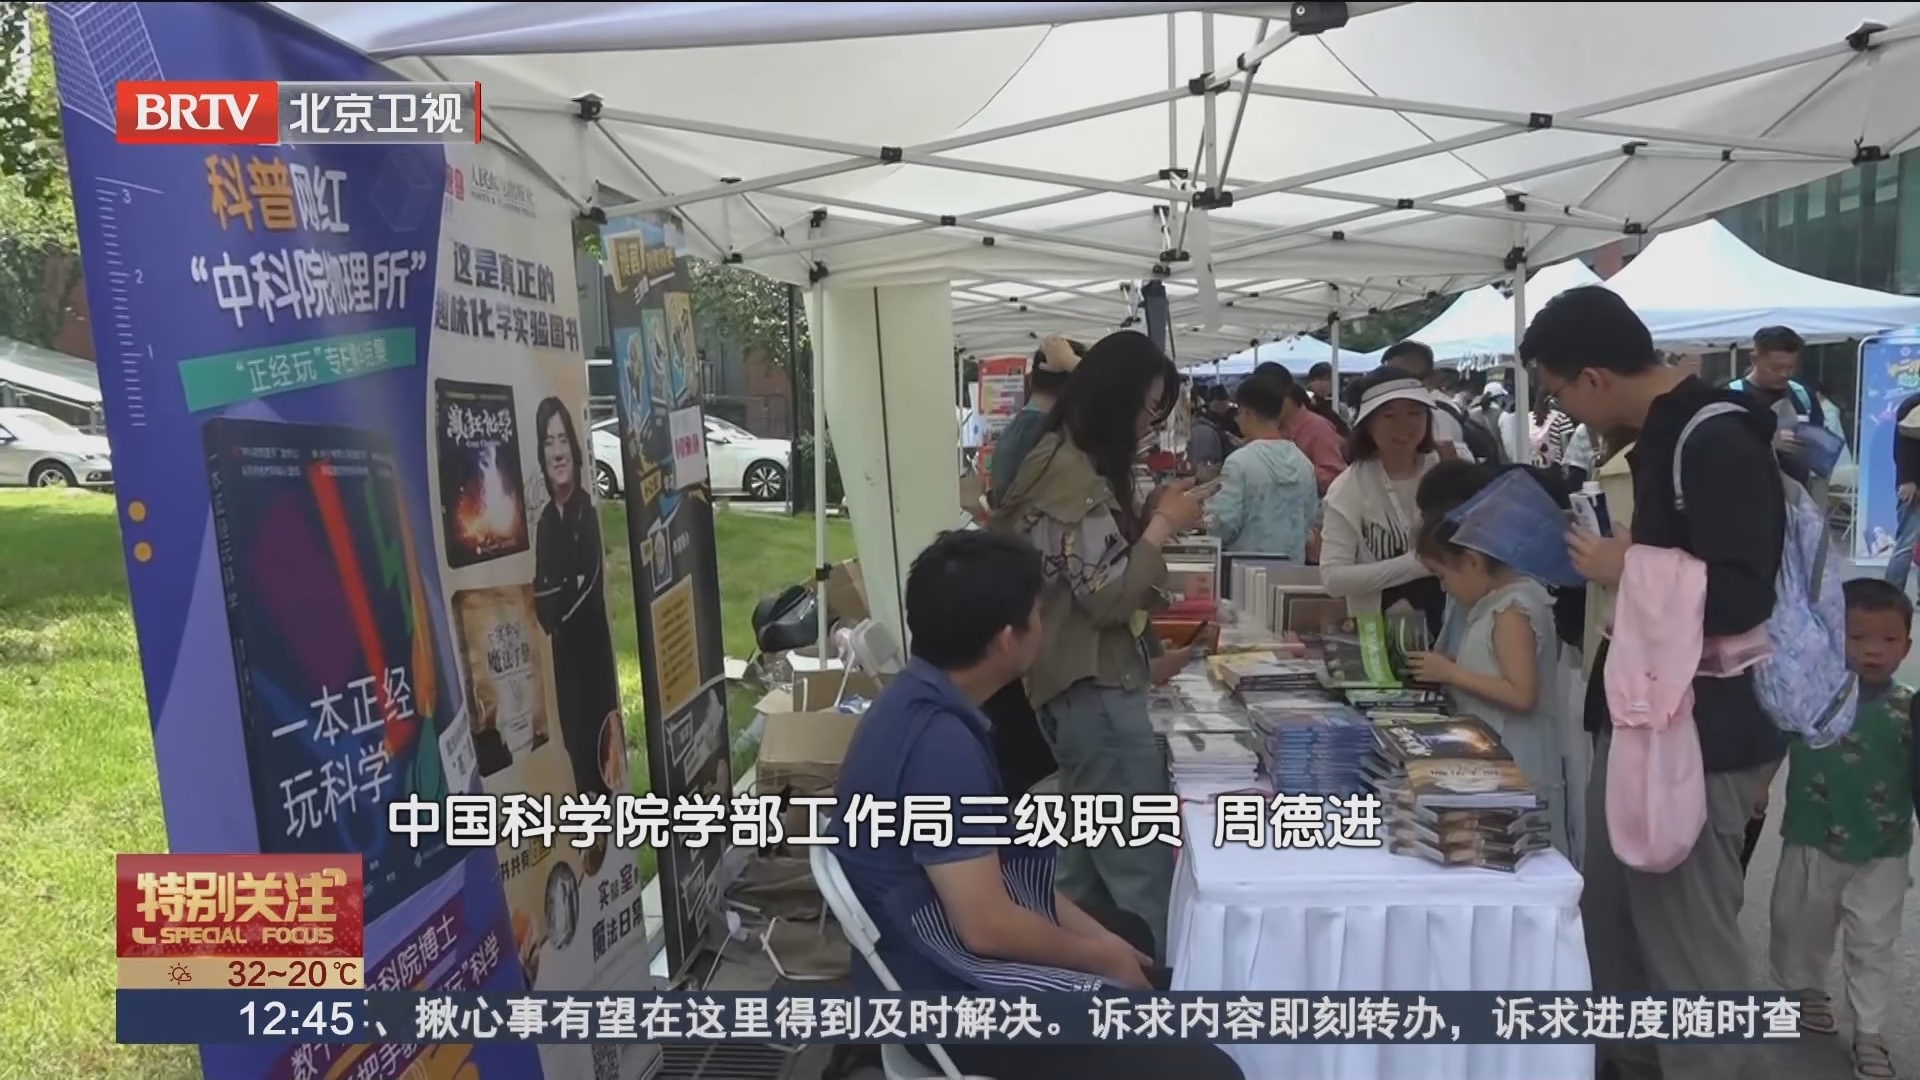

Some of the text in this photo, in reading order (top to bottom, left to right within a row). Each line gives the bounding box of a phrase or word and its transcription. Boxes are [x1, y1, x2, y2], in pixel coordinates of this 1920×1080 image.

[121, 188, 132, 205] 3
[204, 153, 350, 233] 科普网红
[133, 268, 145, 285] 2
[453, 240, 556, 305] 这是真正的
[271, 665, 415, 747] 一本正经
[278, 738, 393, 838] 玩科学
[364, 913, 459, 991] 科院博士
